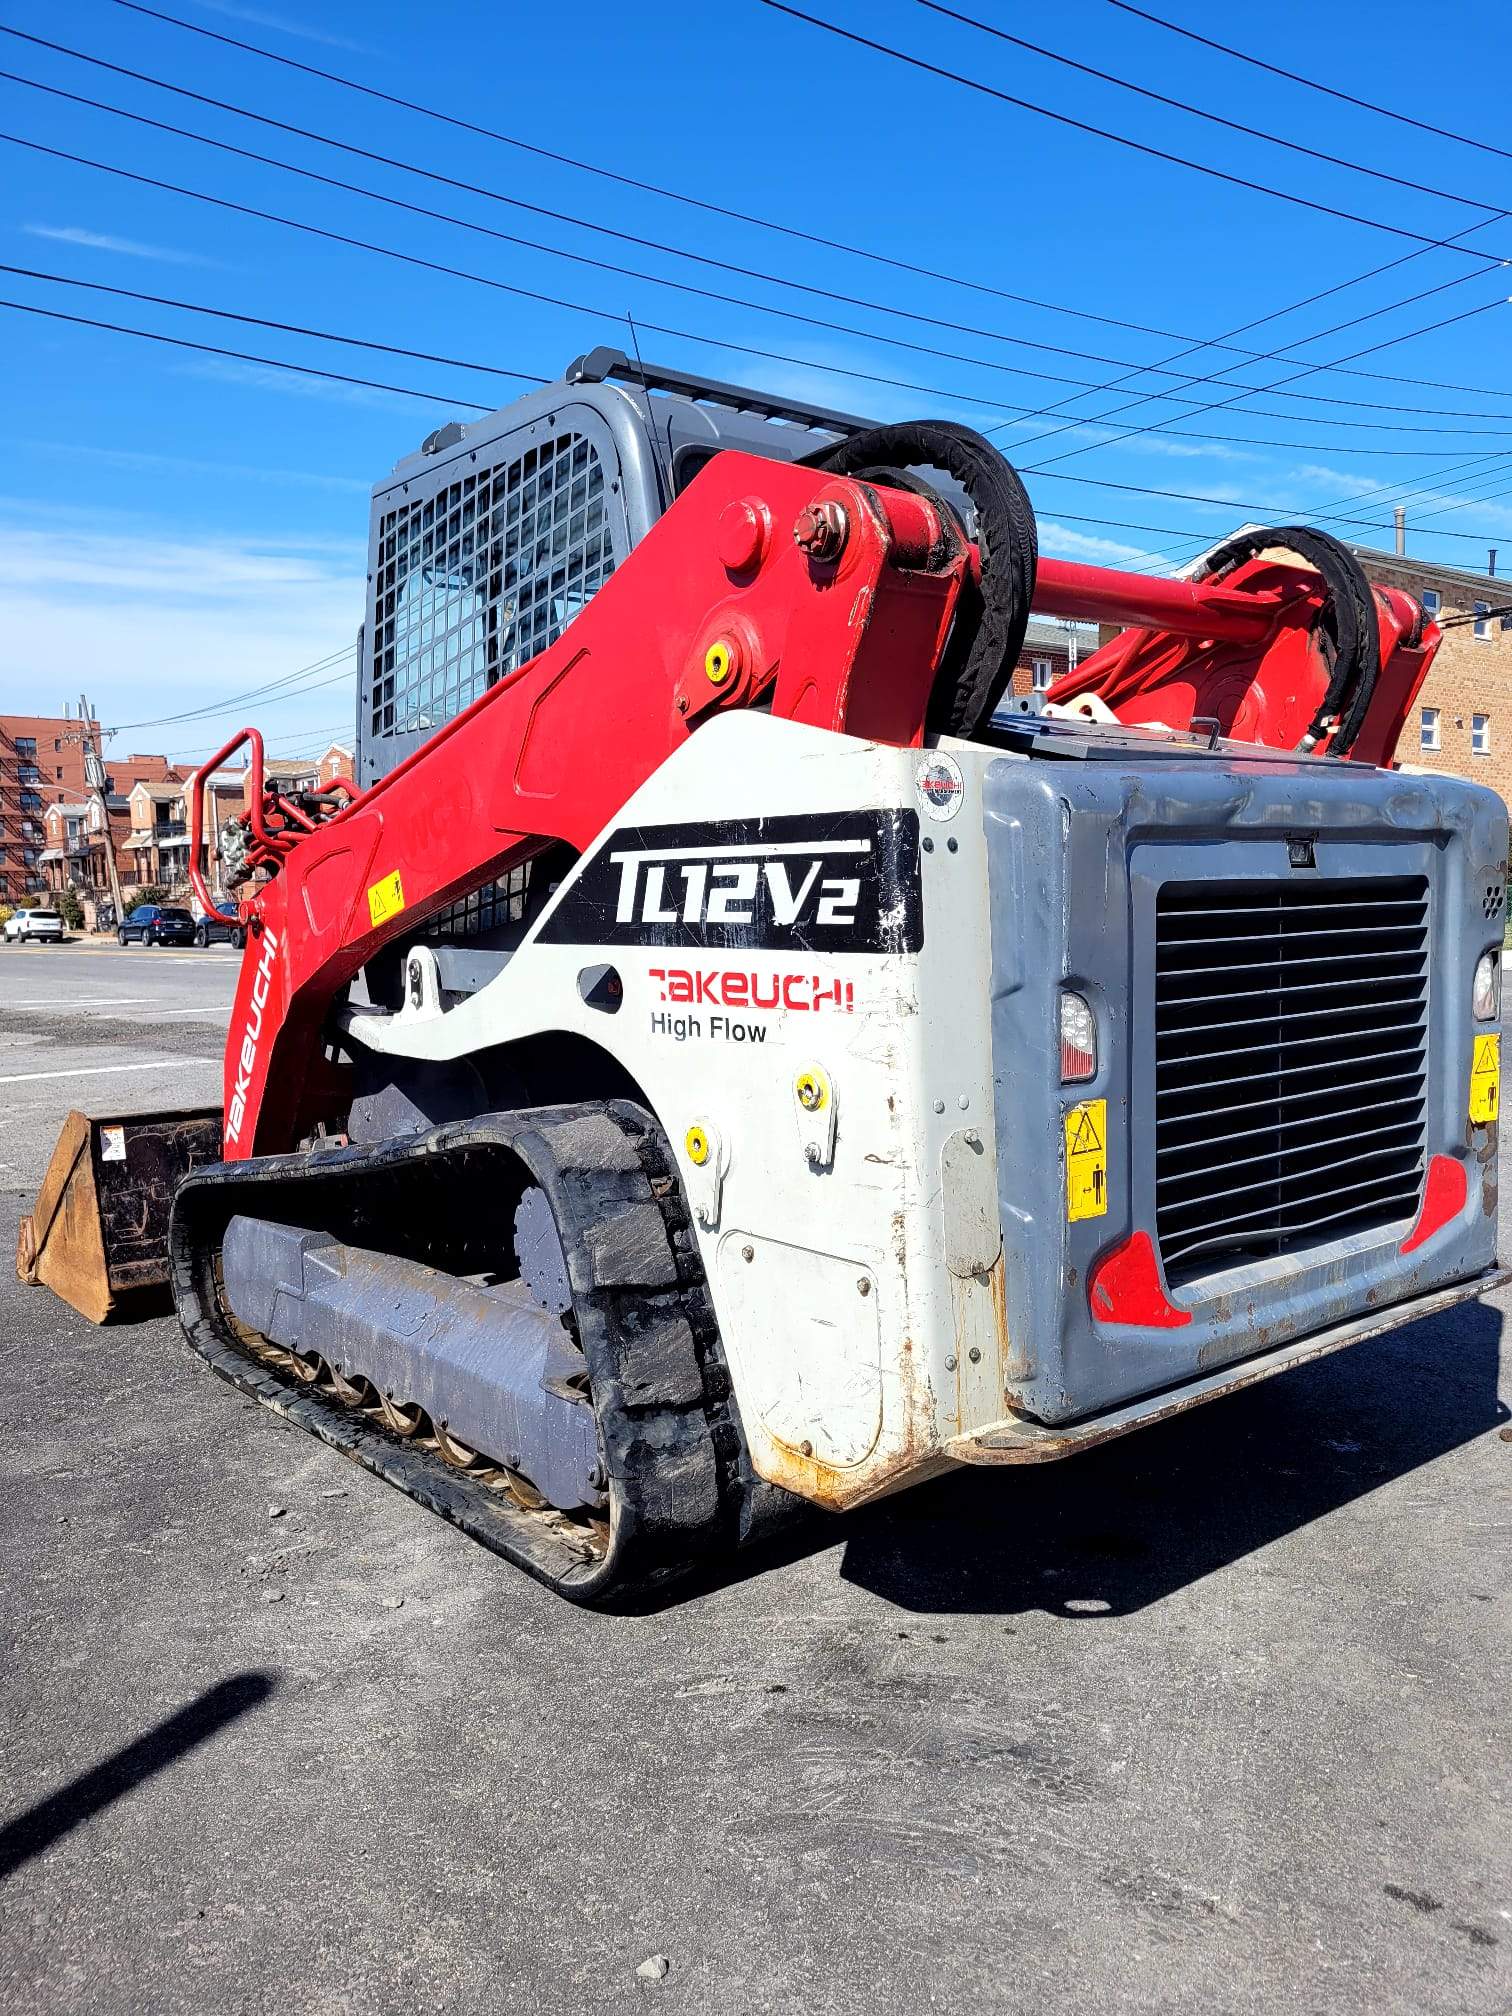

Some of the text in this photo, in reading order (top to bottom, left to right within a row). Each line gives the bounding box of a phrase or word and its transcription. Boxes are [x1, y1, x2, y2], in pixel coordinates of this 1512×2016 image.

[610, 839, 871, 926] TL12V2
[651, 1012, 767, 1043] High Flow
